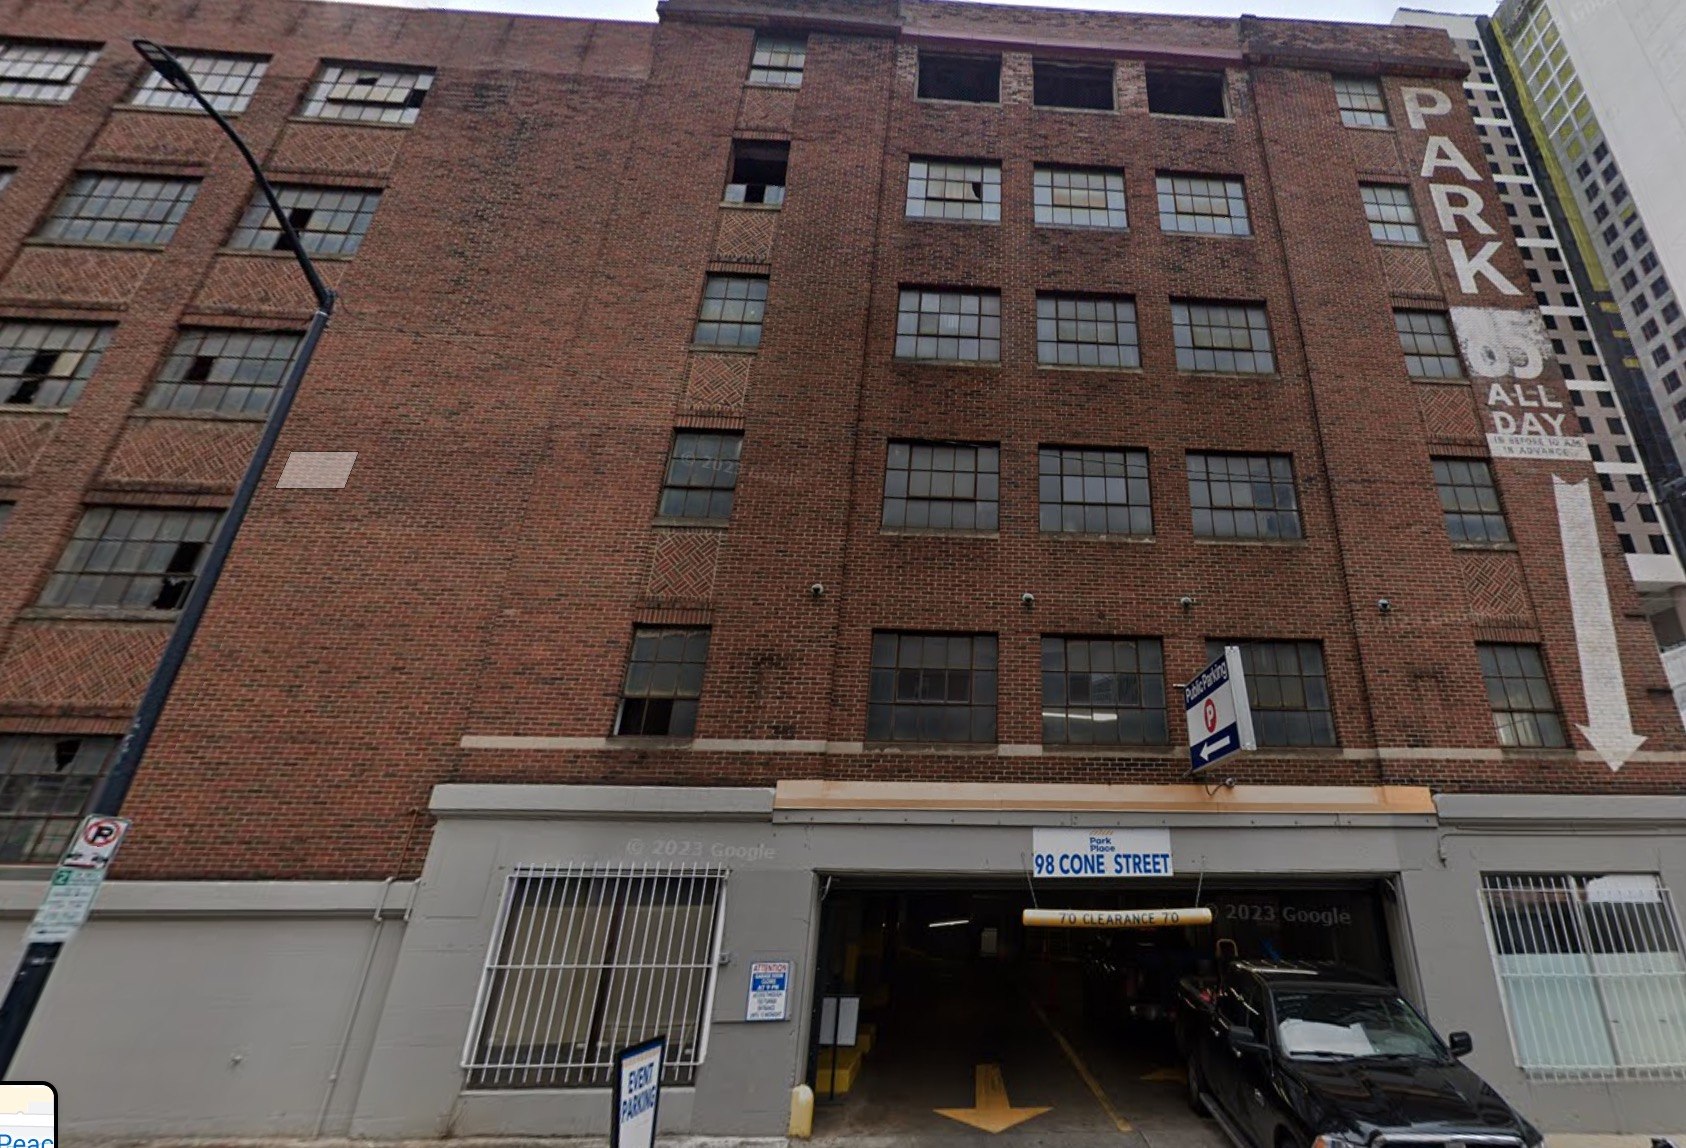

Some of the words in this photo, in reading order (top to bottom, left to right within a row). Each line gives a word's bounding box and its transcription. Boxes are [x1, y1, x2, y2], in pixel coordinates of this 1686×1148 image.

[1400, 87, 1523, 296] PARK
[1488, 383, 1563, 408] ALL
[1492, 411, 1566, 436] DAY
[1185, 682, 1204, 703] Public
[1202, 662, 1228, 690] Parking
[1089, 837, 1112, 845] Park
[1034, 853, 1055, 875] 98
[1059, 853, 1106, 875] CONE
[1114, 853, 1170, 874] STREET
[1060, 913, 1077, 925] 70
[1083, 913, 1155, 925] CLEARANCE
[1161, 911, 1179, 924] 70
[628, 1062, 654, 1094] EVENT
[621, 1085, 656, 1123] PARKING
